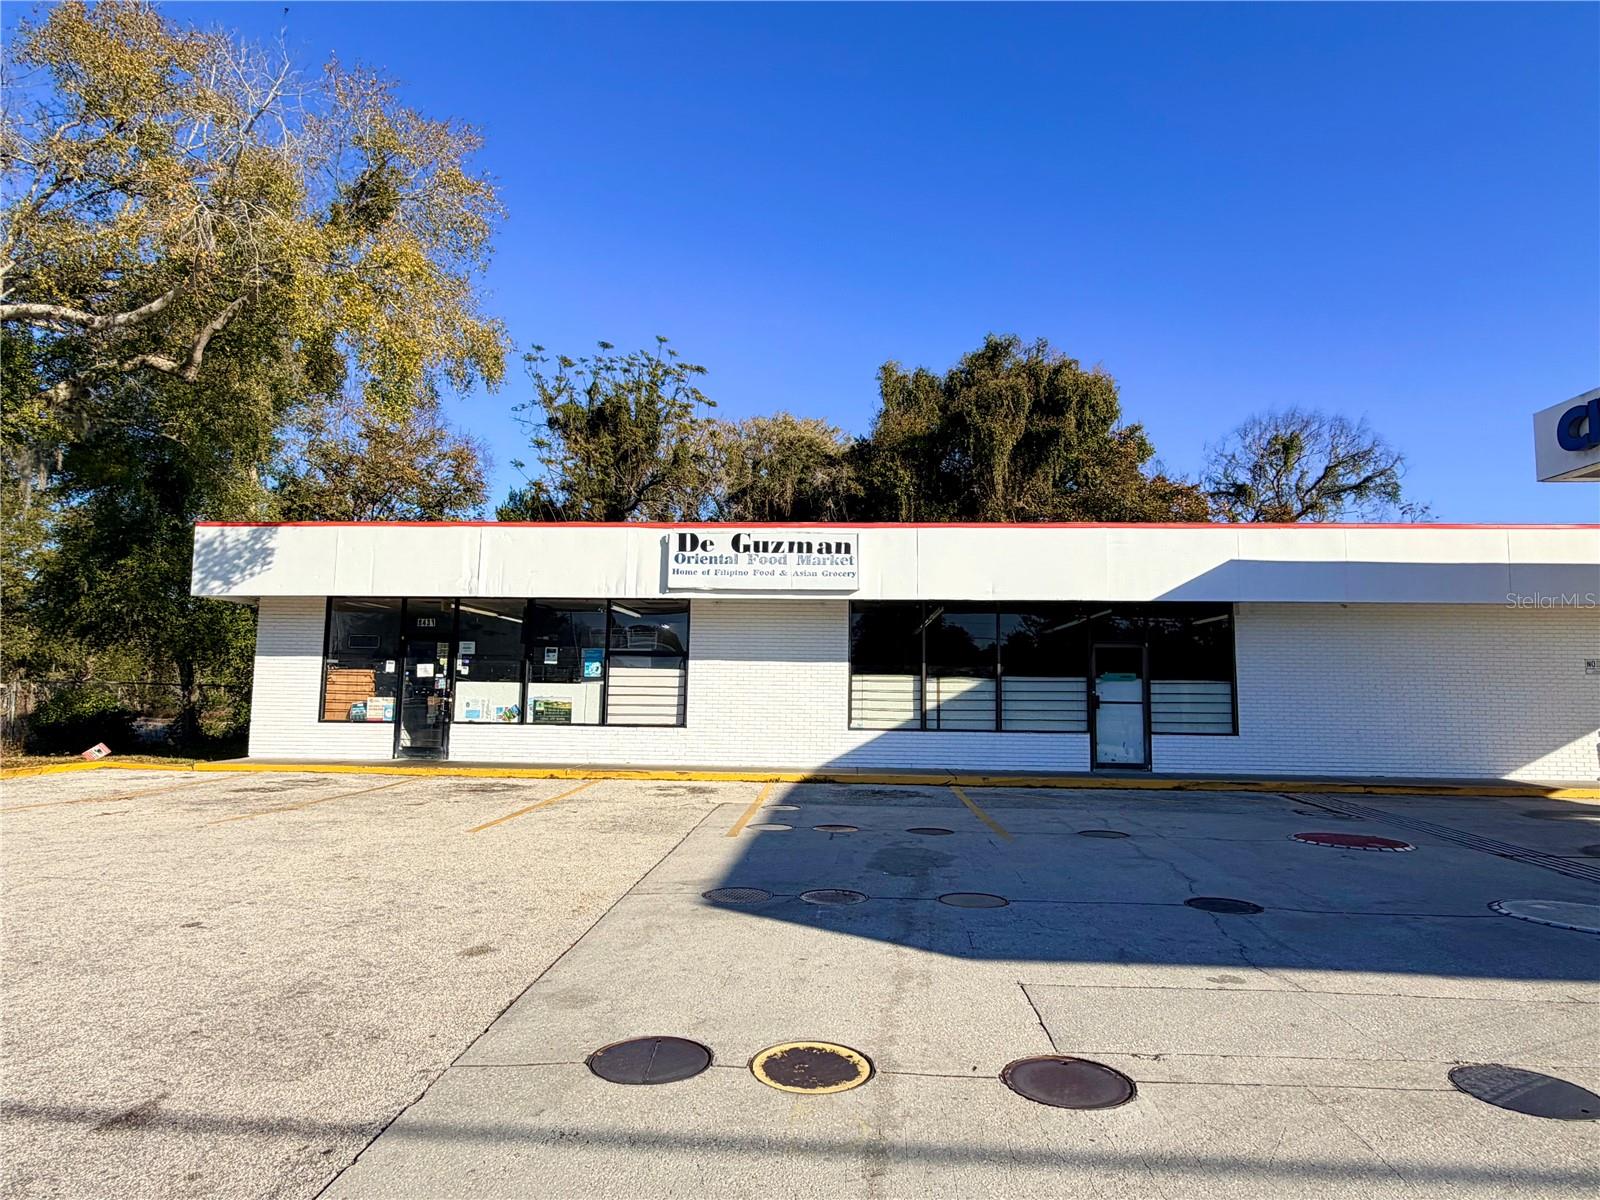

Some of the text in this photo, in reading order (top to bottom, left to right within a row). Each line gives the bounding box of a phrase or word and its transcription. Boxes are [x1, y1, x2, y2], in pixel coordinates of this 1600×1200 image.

[676, 533, 852, 554] De Guzman
[674, 553, 855, 566] Oriental Food Market
[672, 568, 698, 576] Home
[714, 569, 749, 577] Filipino
[822, 570, 856, 578] Grocery
